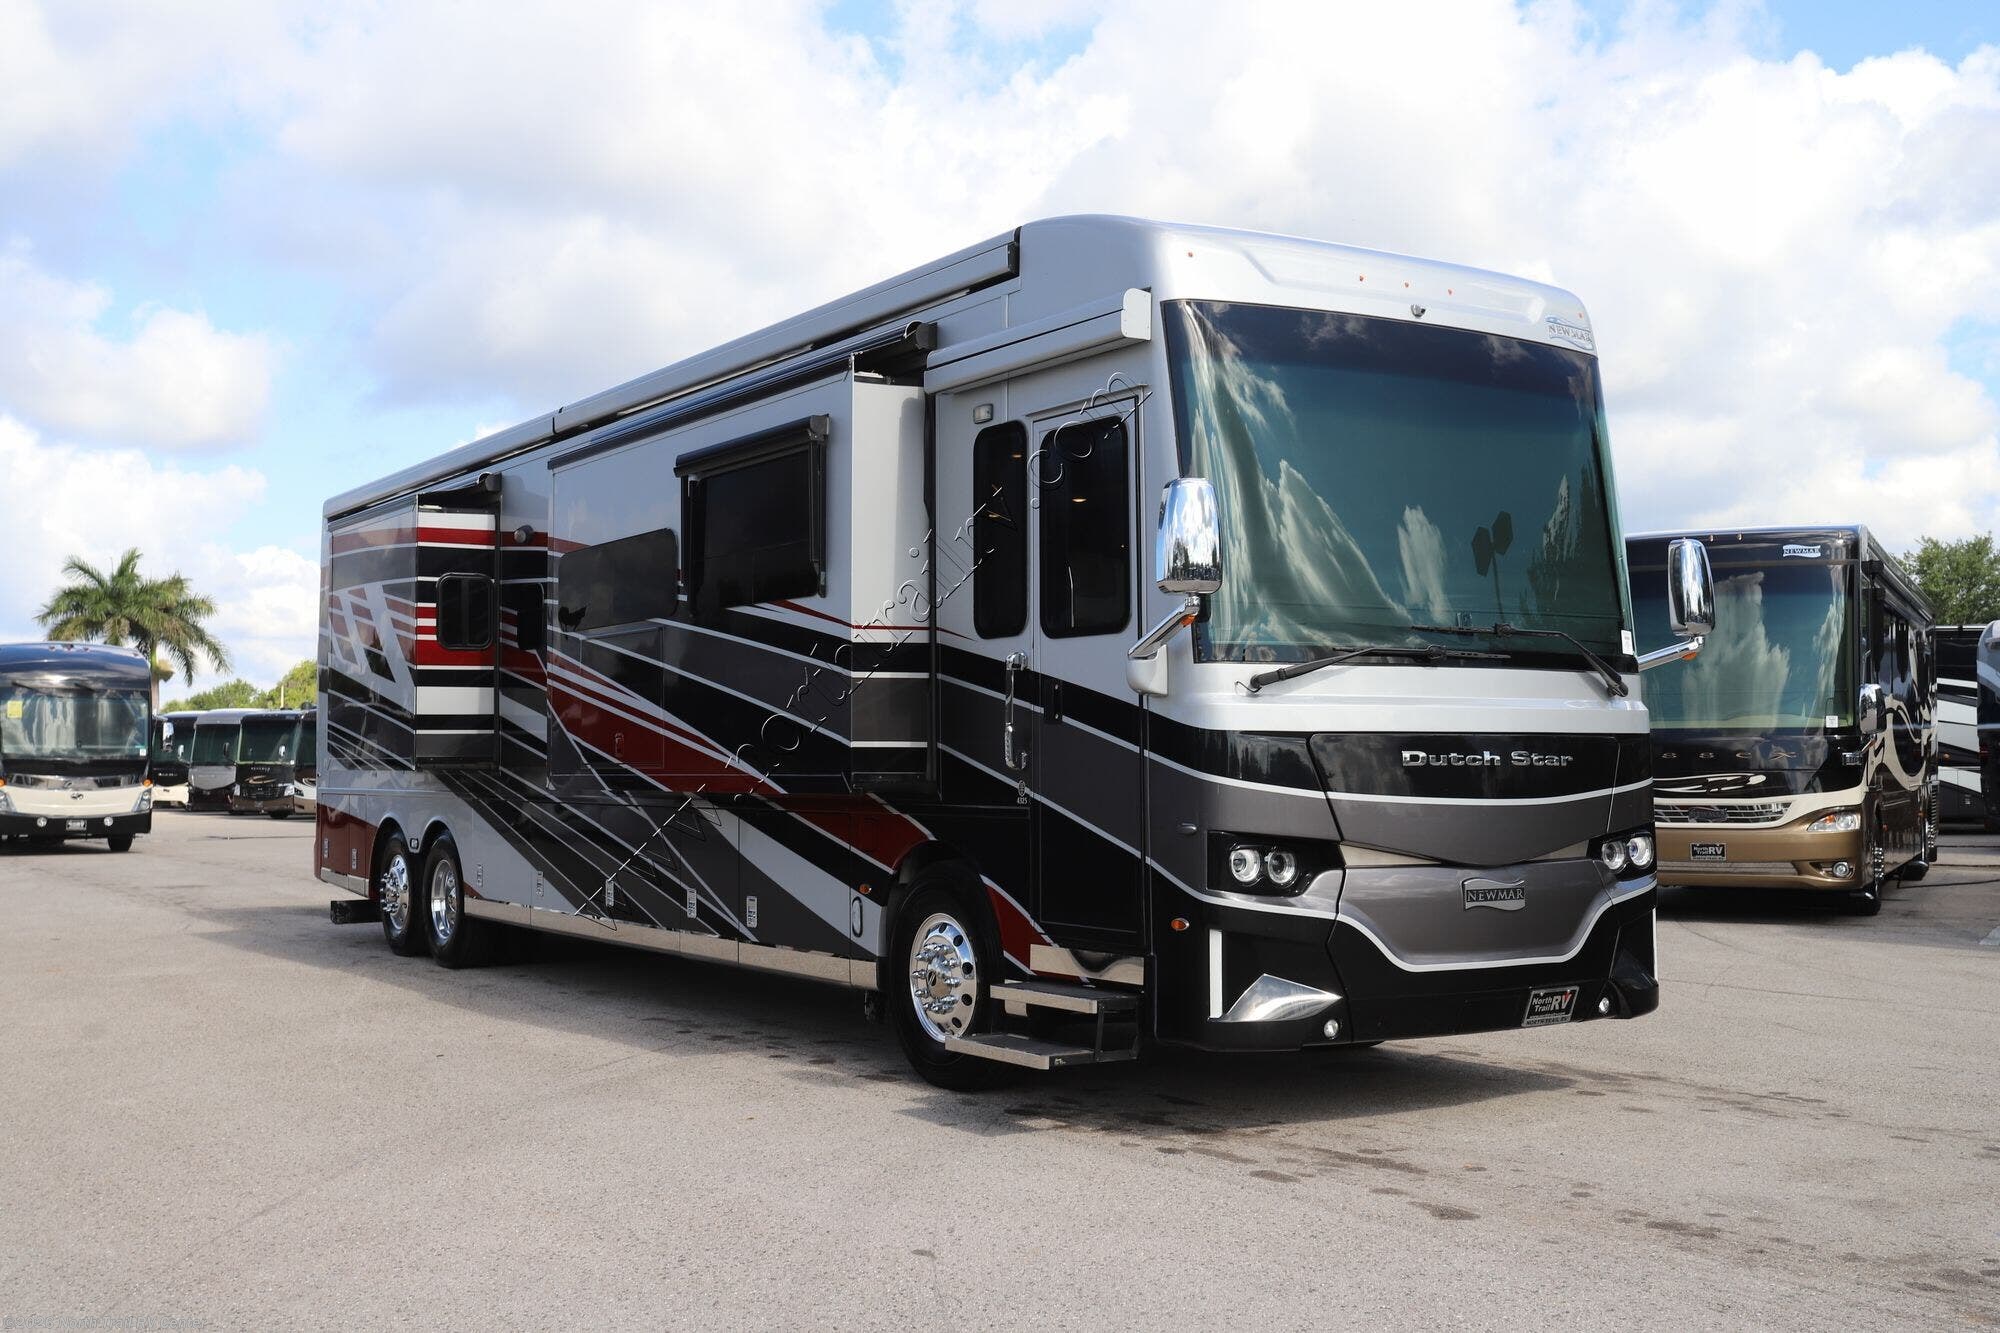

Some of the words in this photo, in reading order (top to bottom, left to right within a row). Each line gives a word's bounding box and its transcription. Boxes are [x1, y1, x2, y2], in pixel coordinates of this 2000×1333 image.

[1548, 324, 1593, 343] NEWMAR
[1402, 750, 1501, 766] Dutch
[1511, 750, 1574, 766] Star
[1708, 846, 1724, 855] RV
[1467, 889, 1525, 902] NEWMAR
[1532, 996, 1553, 1005] North
[1550, 993, 1573, 1011] RV
[1534, 1004, 1551, 1012] Trail
